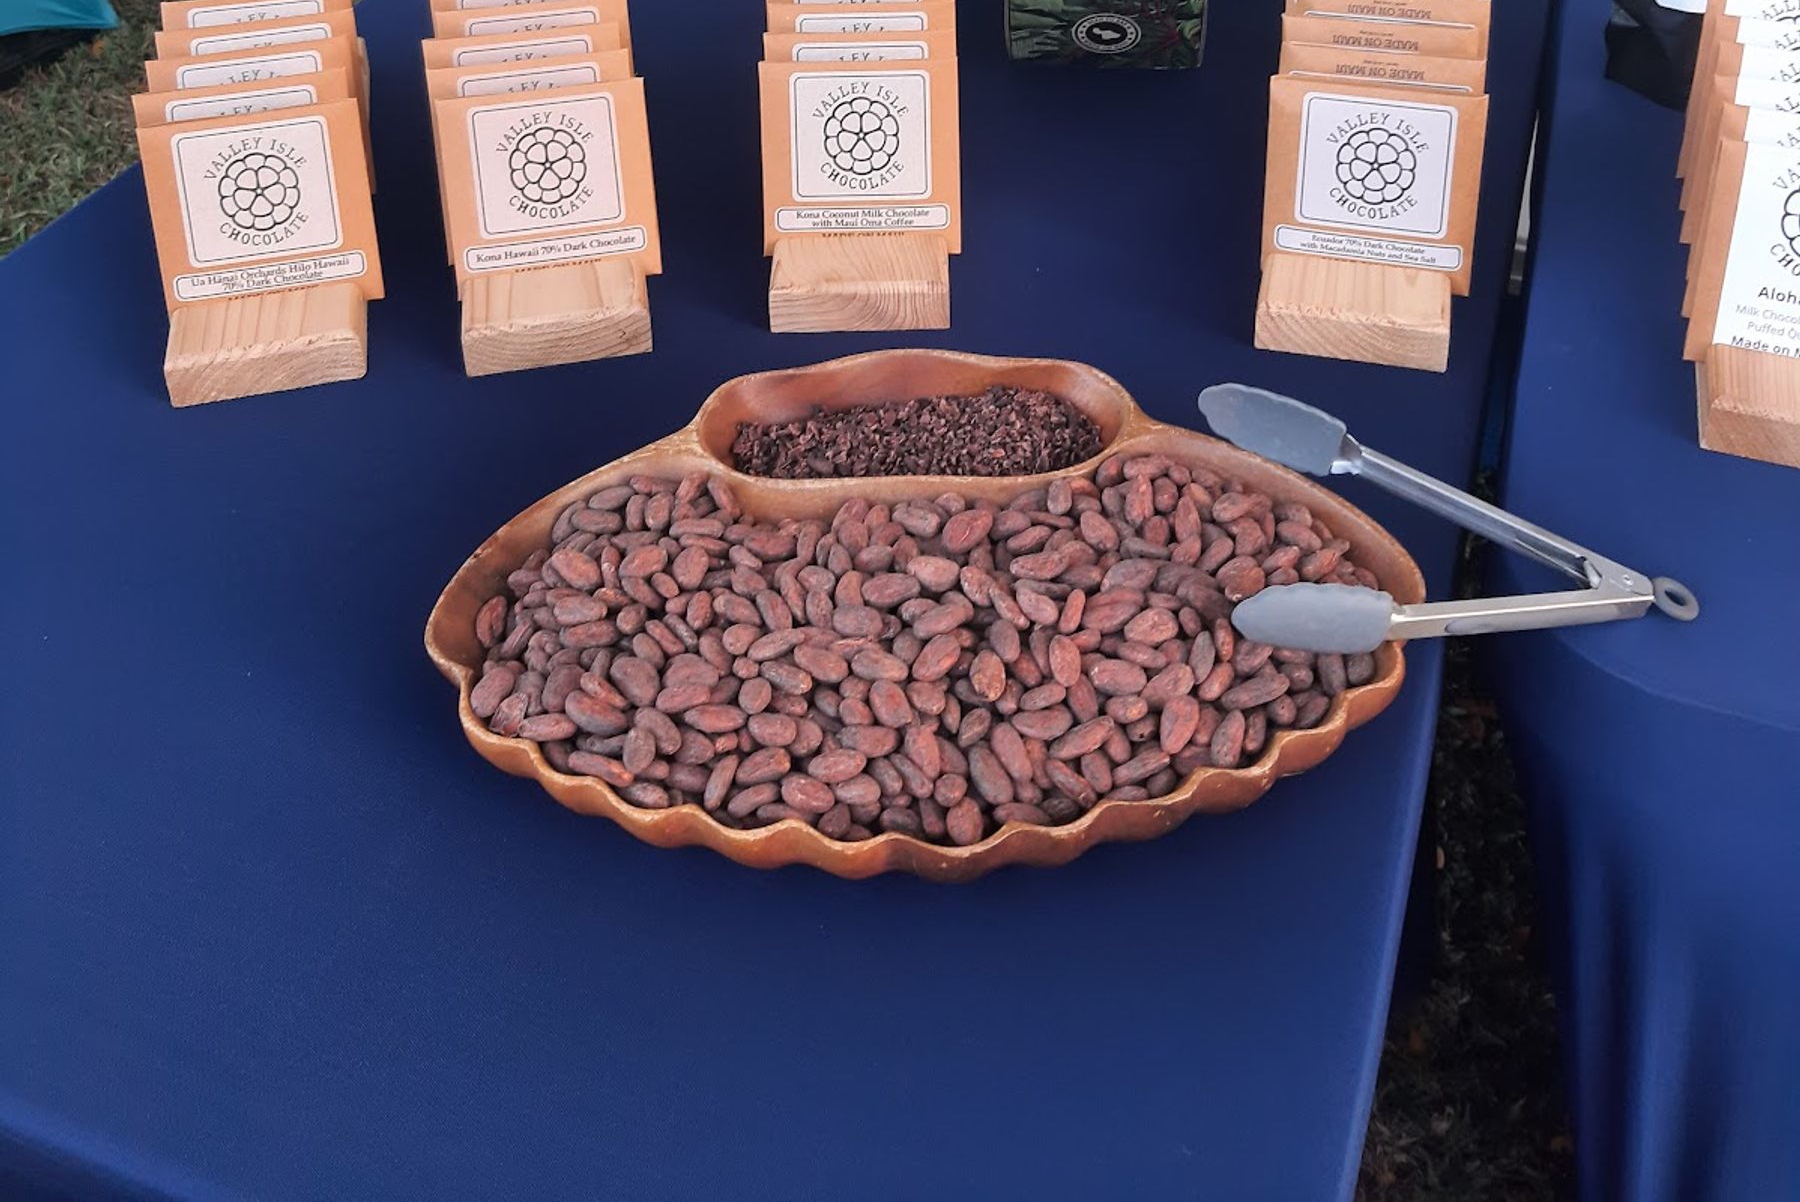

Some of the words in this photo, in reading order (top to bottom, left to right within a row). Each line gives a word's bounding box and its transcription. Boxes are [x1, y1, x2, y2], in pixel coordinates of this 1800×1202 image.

[813, 81, 870, 119] VALLEY
[876, 85, 909, 117] ISLE
[496, 111, 552, 154] VALLEY
[559, 114, 595, 144] ISLE
[1326, 112, 1391, 145] VALLEY
[1396, 119, 1430, 154] ISLE
[204, 137, 262, 180] VALLEY
[270, 139, 307, 168] ISLE
[820, 160, 904, 190] CHOCOLATE
[509, 186, 594, 219] CHOCOLATE
[796, 211, 820, 219] Kona
[822, 210, 859, 218] Coconut
[861, 209, 883, 218] Milk
[885, 208, 930, 218] Chocolate
[1329, 187, 1418, 220] CHOCOLATE
[219, 212, 309, 246] CHOCOLATE
[812, 219, 832, 227] with
[835, 219, 858, 227] Maui
[860, 219, 882, 227] Oma
[884, 218, 914, 226] Coffee
[476, 253, 501, 263] Kona
[504, 250, 539, 260] Hawaii
[541, 246, 562, 256] 70%
[563, 242, 588, 252] Dark
[590, 235, 636, 248] Chocolate
[1312, 234, 1344, 245] Ecuador
[1345, 238, 1362, 247] 70%
[1364, 240, 1382, 249] Dark
[1386, 243, 1425, 254] Chocolate
[1367, 249, 1385, 258] Nuts
[1405, 254, 1418, 262] Sea
[1420, 256, 1436, 264] Salt
[191, 277, 206, 287] Ua
[241, 267, 287, 281] Orchards
[289, 262, 311, 274] Hilo
[313, 257, 350, 270] Hawaii
[246, 278, 271, 288] Dark
[274, 271, 323, 284] Chocolate
[1758, 286, 1800, 305] Aloh
[1736, 304, 1760, 317] Milk
[1748, 321, 1785, 336] Puffed
[1731, 335, 1769, 352] Made
[1773, 345, 1790, 357] on
